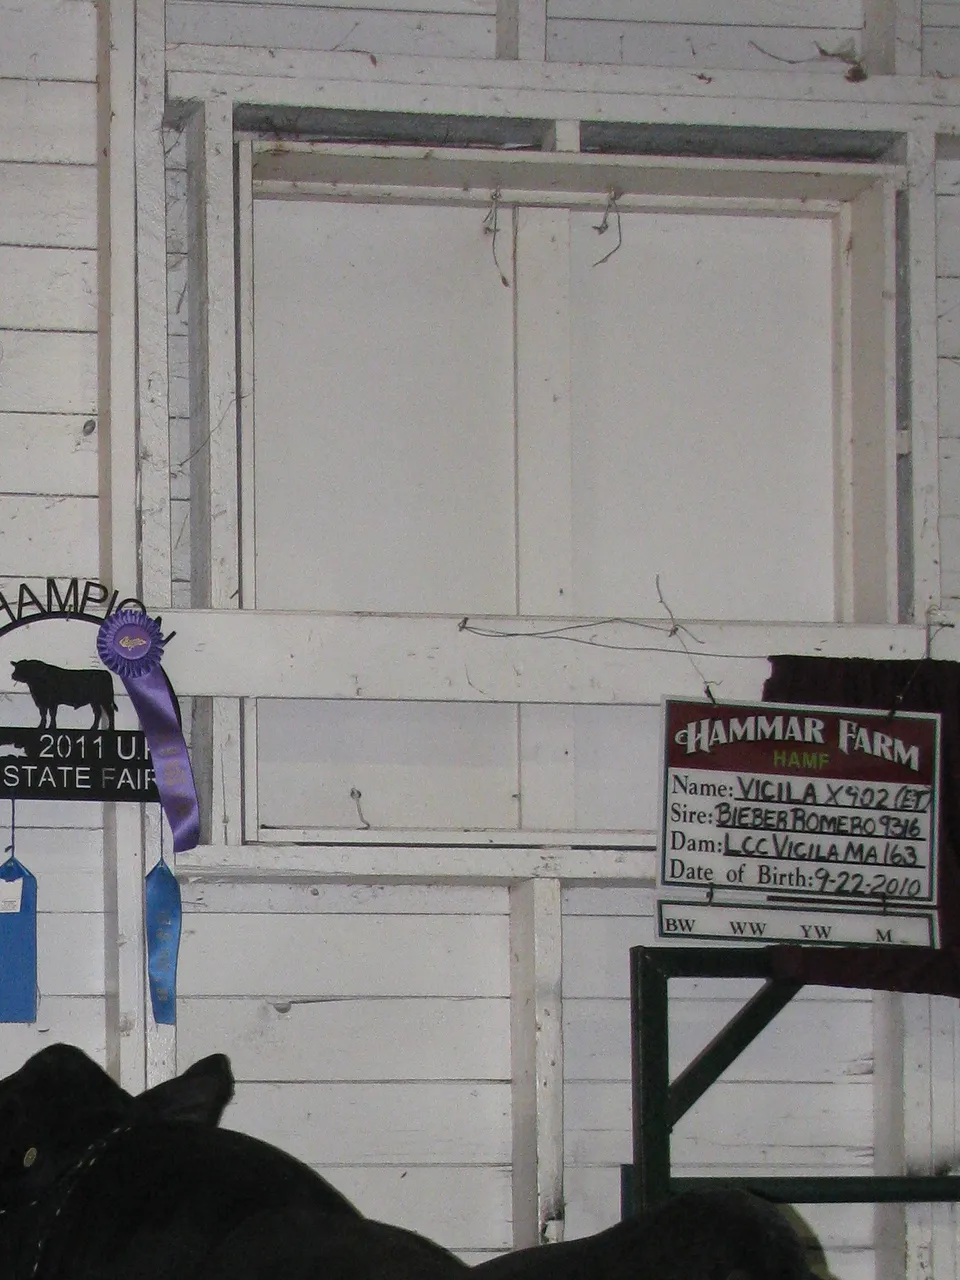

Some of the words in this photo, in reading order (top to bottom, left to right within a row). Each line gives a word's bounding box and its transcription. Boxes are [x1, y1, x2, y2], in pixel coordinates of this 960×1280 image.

[39, 734, 103, 759] 2011
[674, 715, 825, 755] HAMMAR
[839, 719, 920, 772] FARM
[773, 751, 830, 769] HAMF
[3, 767, 91, 789] STATE
[671, 775, 734, 797] Name:
[736, 776, 817, 803] VICILA
[670, 803, 713, 823] Sire:
[715, 802, 787, 830] BIEBER
[791, 808, 876, 836] ROMERO
[879, 816, 921, 838] 9316
[670, 831, 723, 853] Dam:
[724, 833, 769, 856] LCC
[884, 842, 918, 866] 163
[670, 859, 714, 881] Date
[726, 864, 746, 883] of
[758, 864, 813, 888] Birth:
[814, 868, 921, 897] 9-22-2010
[665, 917, 695, 933] BW
[729, 921, 768, 937] WW
[800, 924, 832, 940] YW
[876, 928, 892, 943] M
